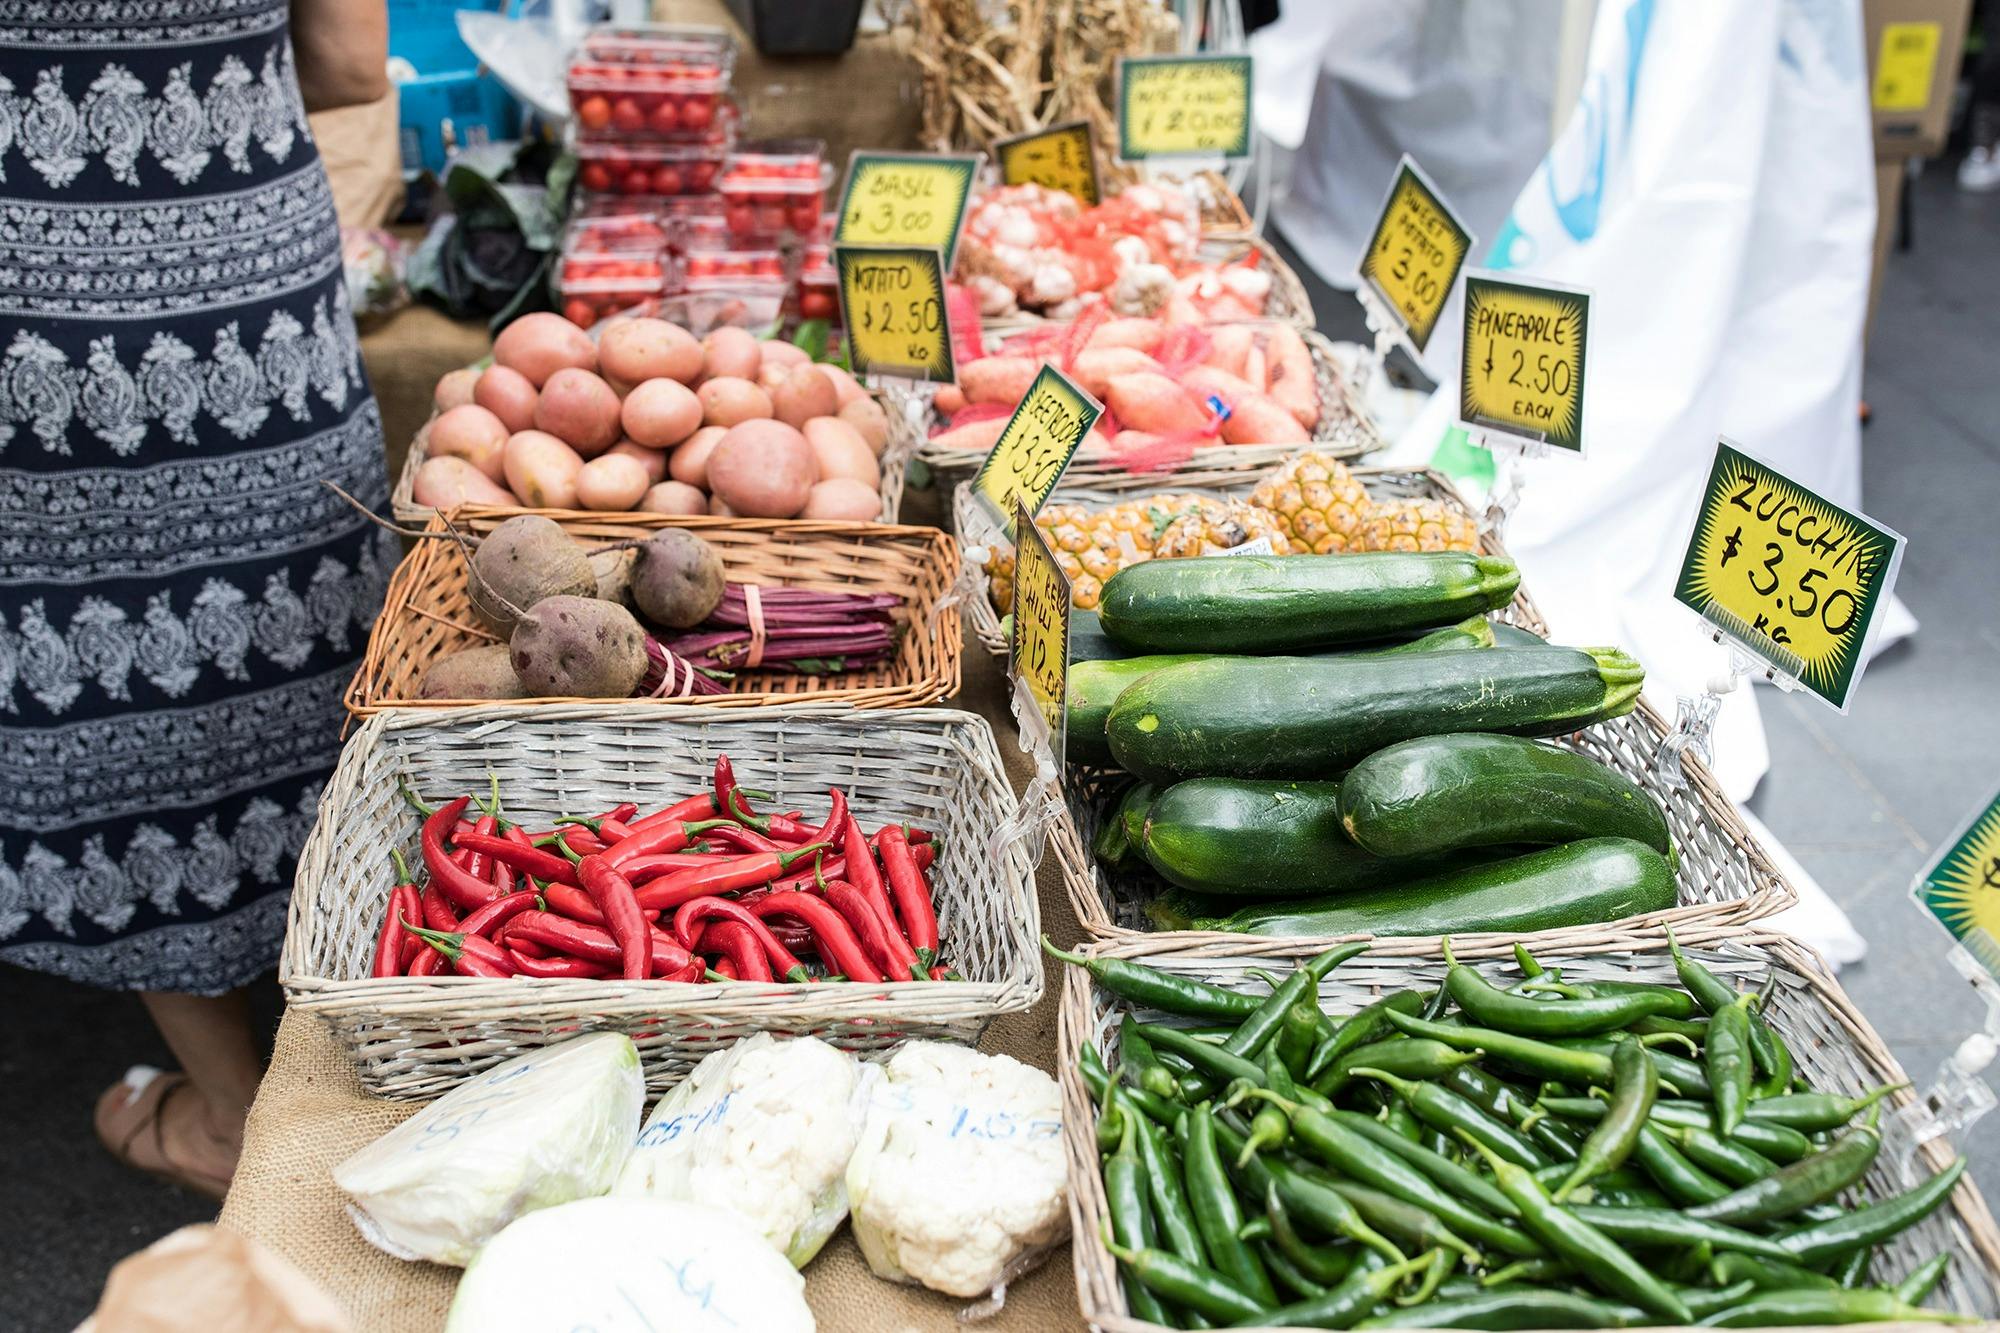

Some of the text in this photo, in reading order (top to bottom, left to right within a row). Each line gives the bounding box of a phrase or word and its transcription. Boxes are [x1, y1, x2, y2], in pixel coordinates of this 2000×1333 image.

[869, 173, 934, 200] BASIL
[1477, 303, 1570, 345] PINEAPPLE
[1513, 400, 1554, 421] EACH
[1730, 473, 1887, 588] ZUCCHINI
